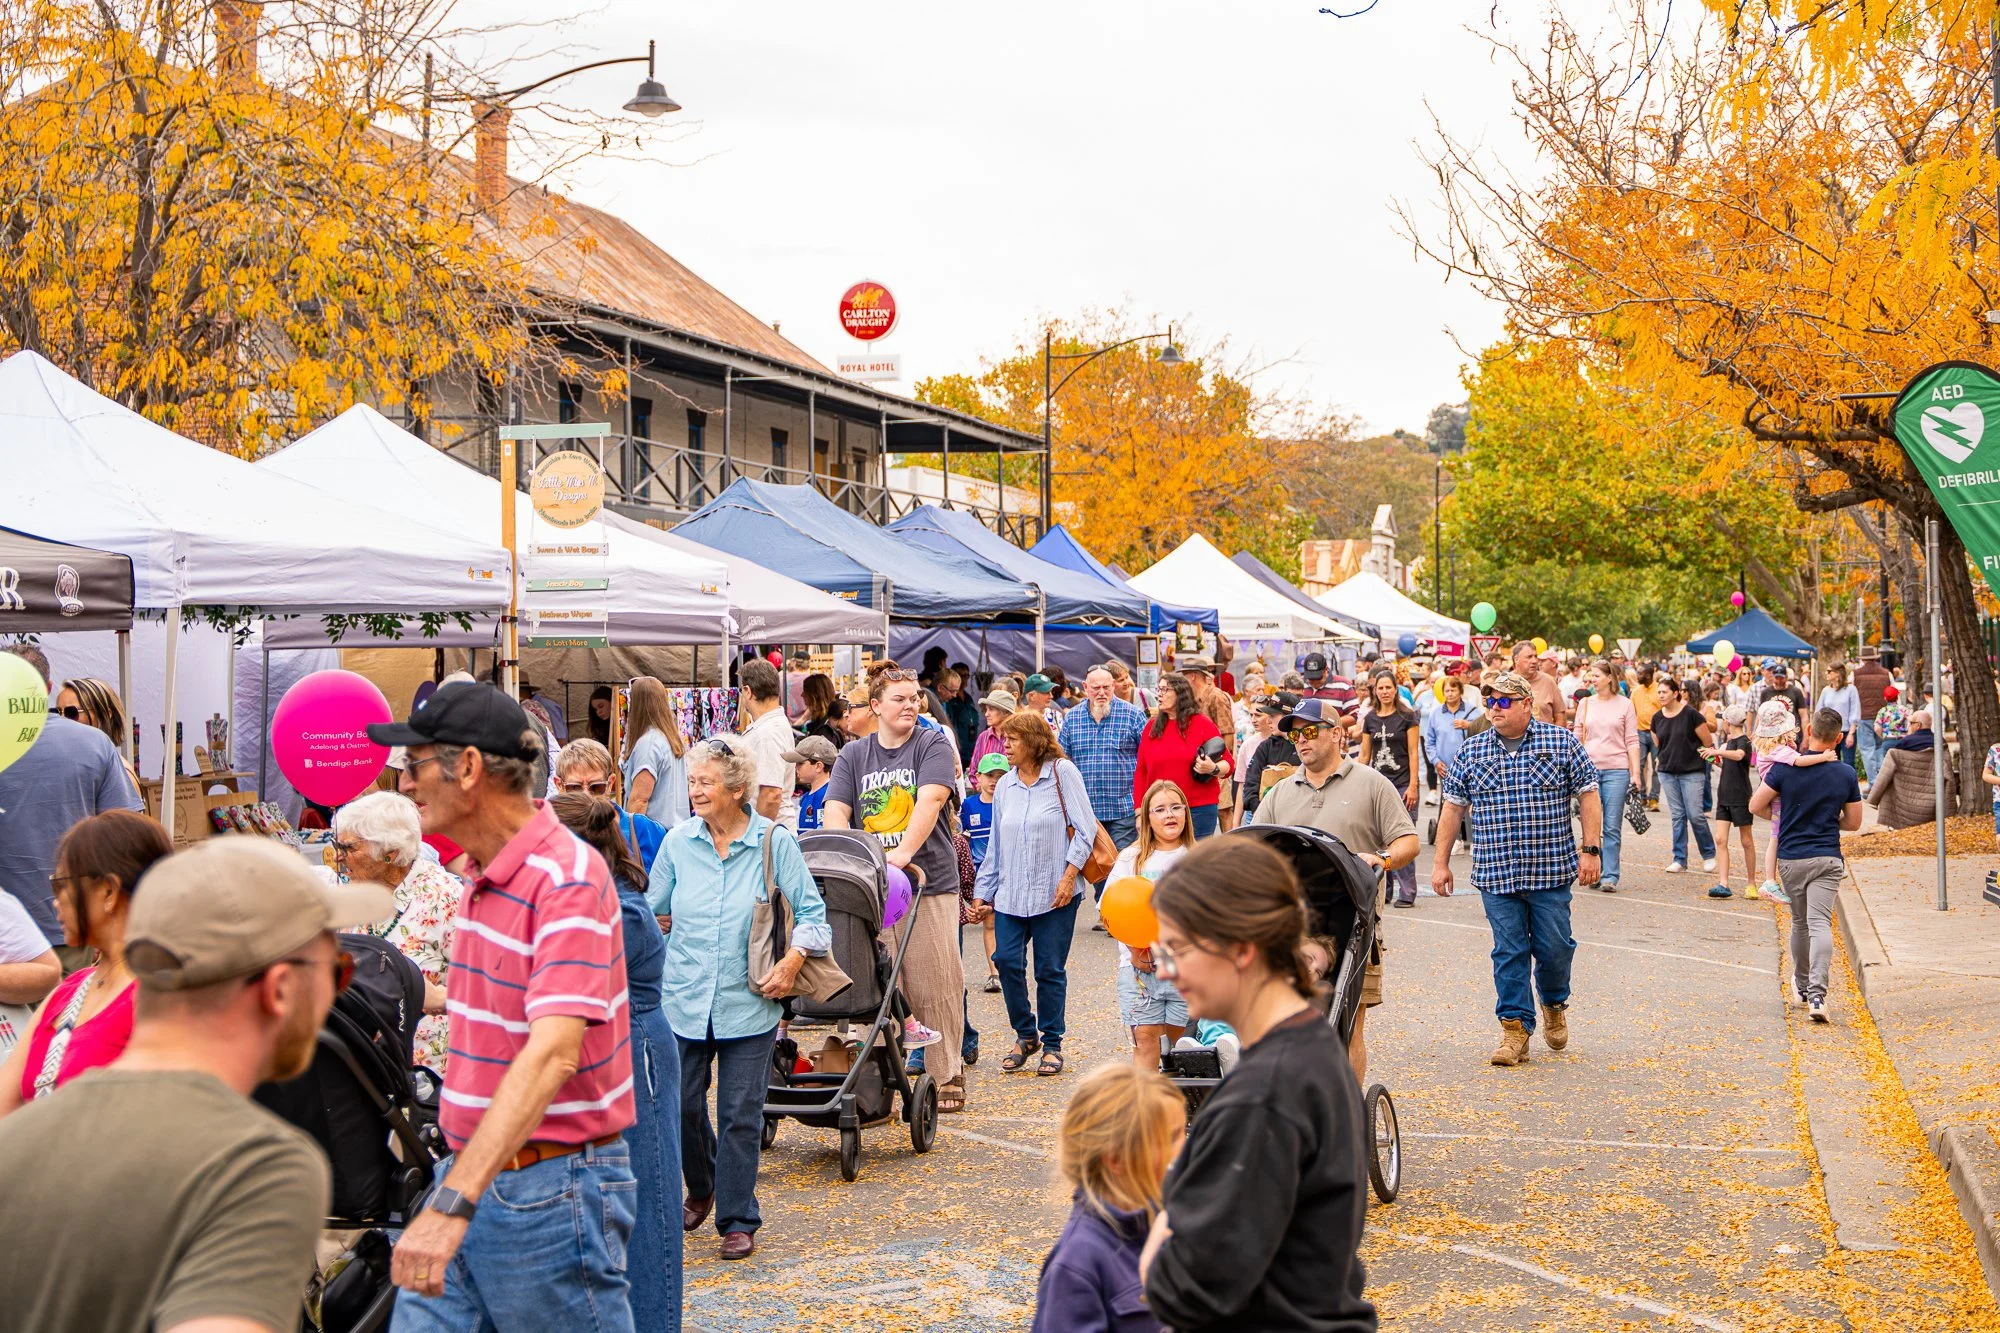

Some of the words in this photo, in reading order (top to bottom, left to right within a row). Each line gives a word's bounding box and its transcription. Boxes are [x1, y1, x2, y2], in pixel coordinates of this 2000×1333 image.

[843, 309, 890, 318] CARLTON
[845, 319, 889, 327] DRAUGHT
[840, 364, 866, 372] ROYAL
[870, 363, 895, 371] HOTEL
[1931, 384, 1964, 401] AED
[1938, 469, 2000, 489] DEFIBRIL
[539, 611, 569, 620] Makeup
[301, 731, 354, 740] Community
[356, 730, 367, 738] Ba
[310, 743, 339, 751] Adelong
[316, 760, 352, 768] Bendigo
[353, 758, 373, 766] Bank
[861, 767, 916, 793] TRÓPICO
